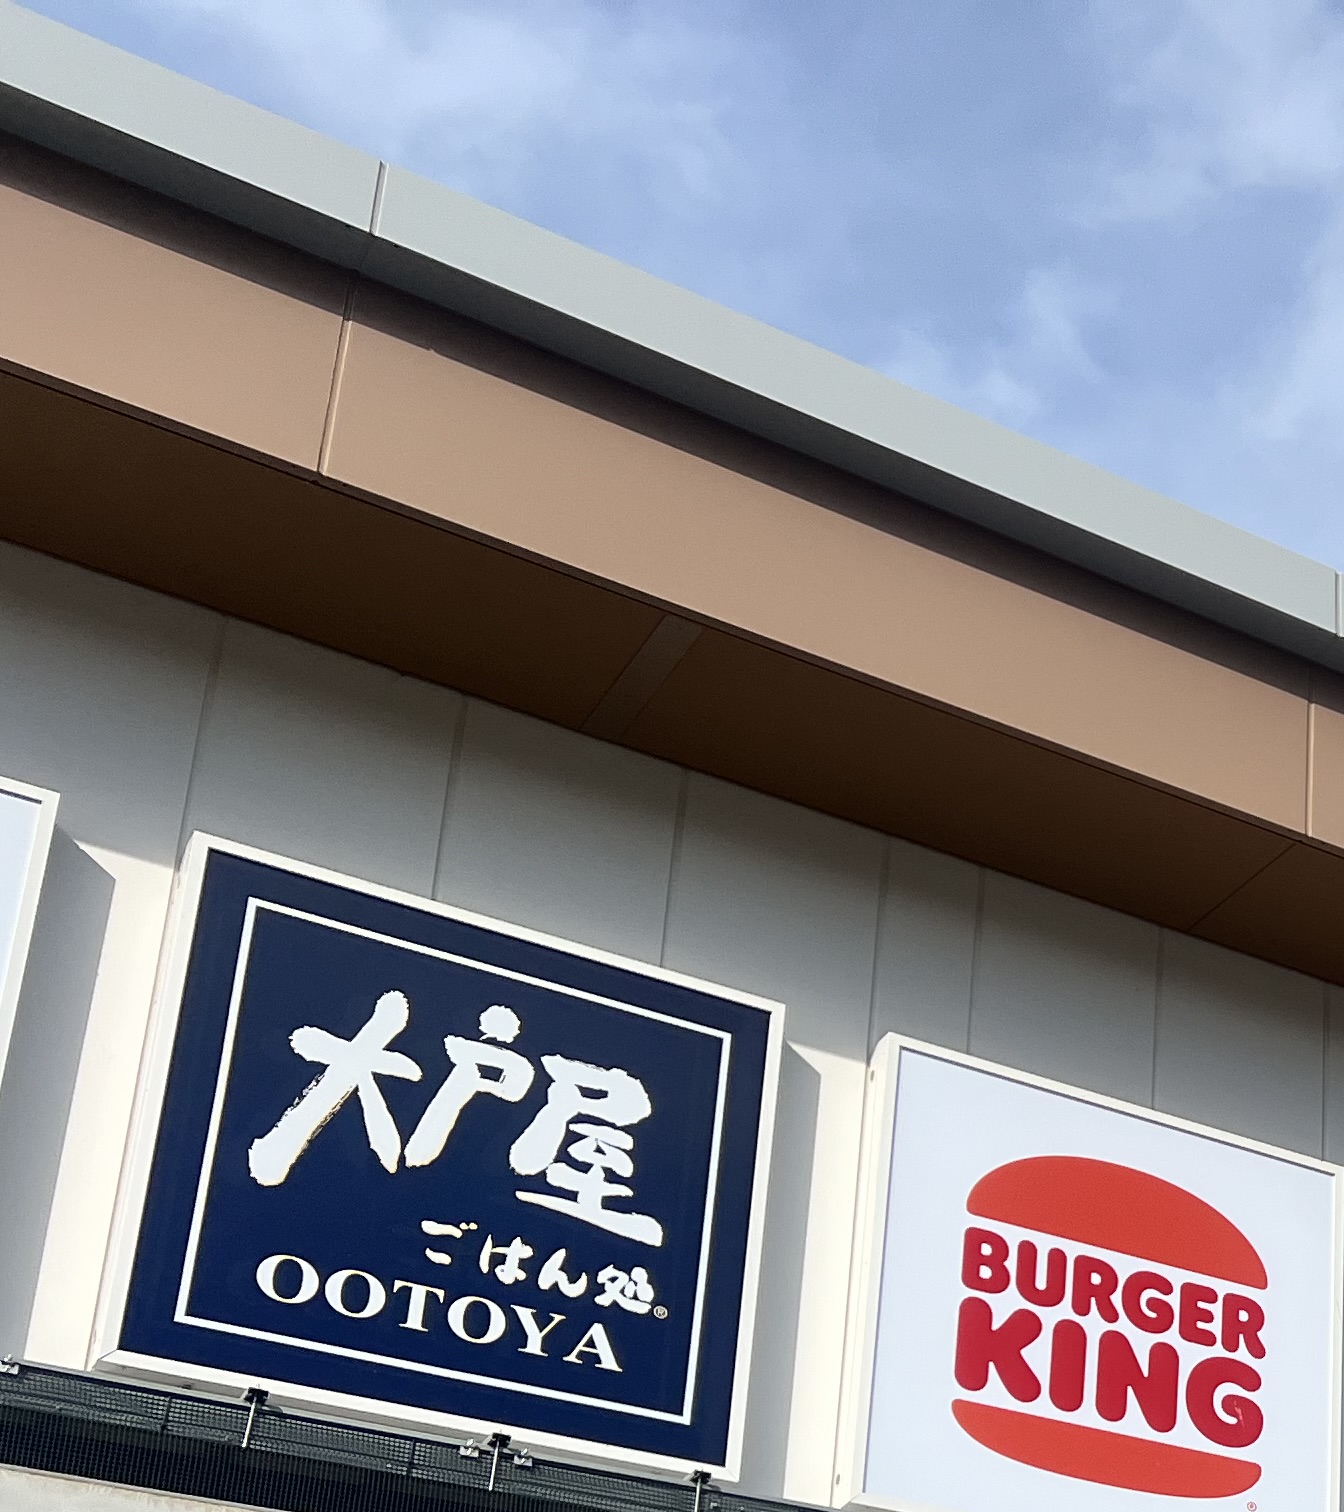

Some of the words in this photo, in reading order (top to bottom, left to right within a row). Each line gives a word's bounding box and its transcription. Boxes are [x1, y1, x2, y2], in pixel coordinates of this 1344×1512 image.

[255, 1254, 623, 1373] OOTOYA
[421, 1218, 655, 1316] ごはん処
[961, 1225, 1267, 1360] BURGER
[953, 1296, 1266, 1449] KING
